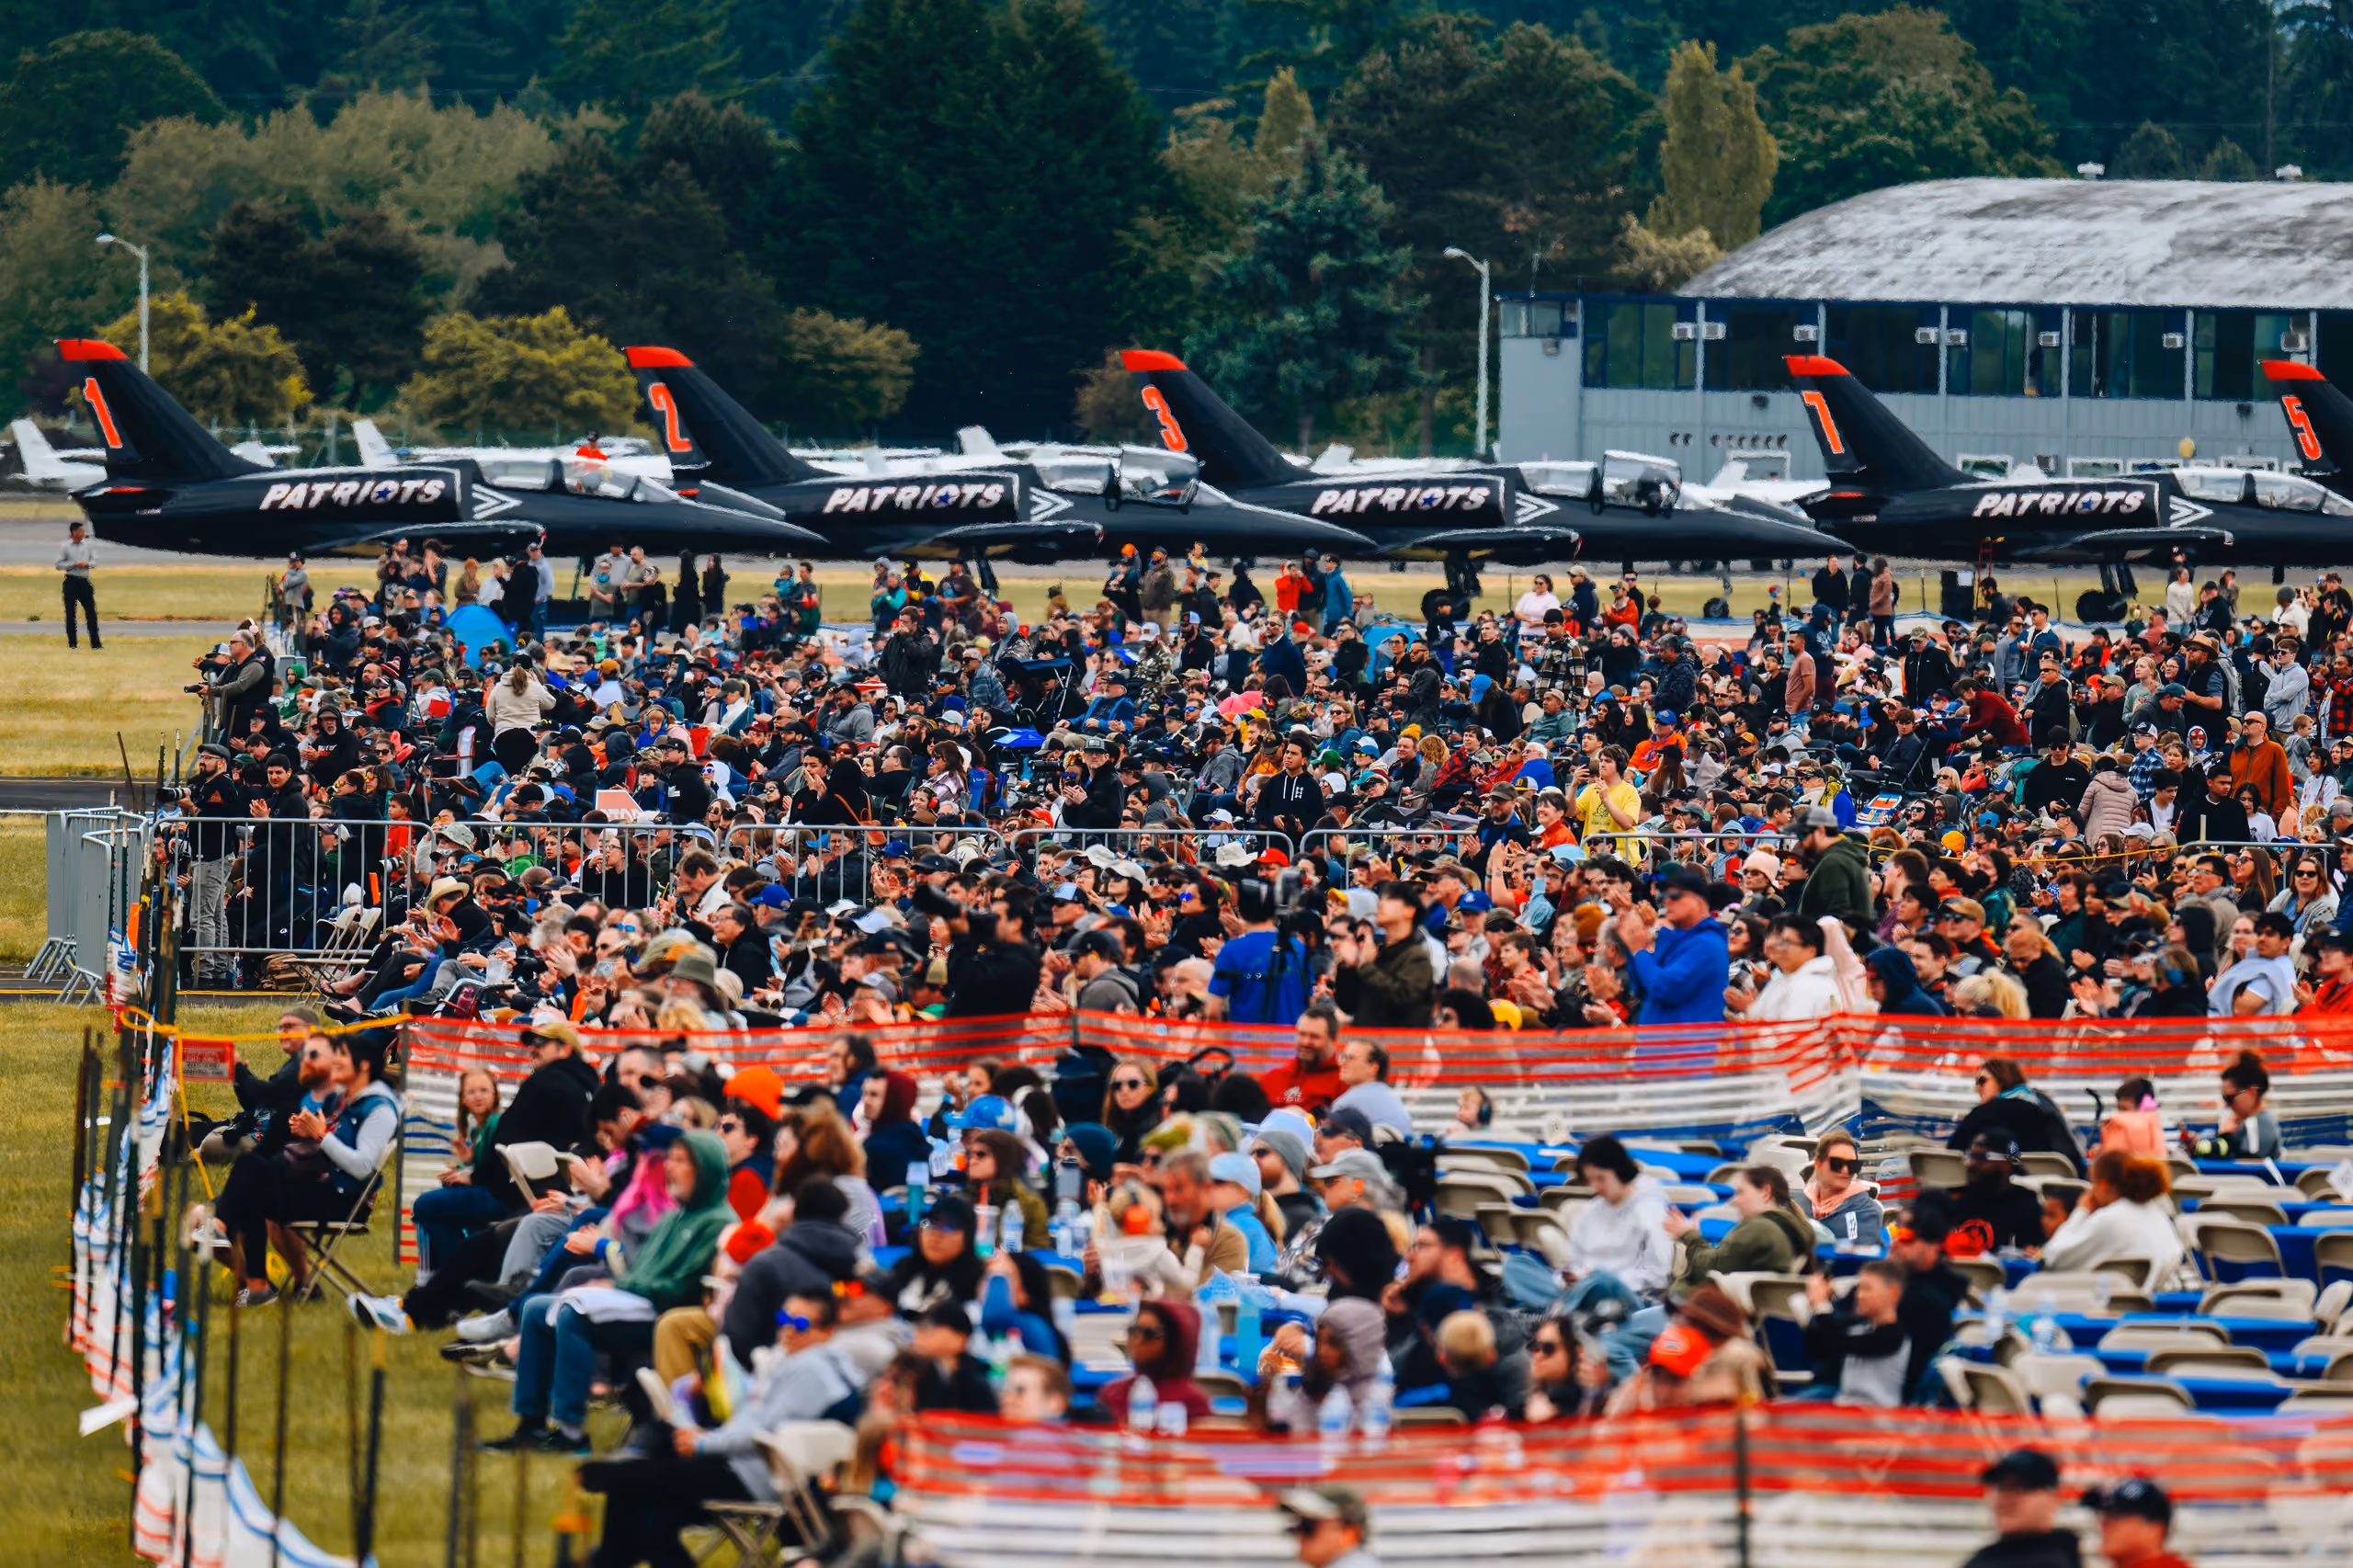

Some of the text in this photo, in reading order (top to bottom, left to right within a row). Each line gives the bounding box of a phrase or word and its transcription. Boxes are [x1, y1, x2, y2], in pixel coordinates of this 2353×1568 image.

[83, 377, 123, 449] 1
[648, 382, 693, 452] 2
[1141, 384, 1188, 452] 3
[2281, 395, 2322, 460] 5
[258, 479, 446, 510] PATRIOTS
[822, 483, 1005, 514] PATRIOTS
[1310, 486, 1490, 516] PATRIOTS
[1972, 491, 2146, 517] PATRIOTS
